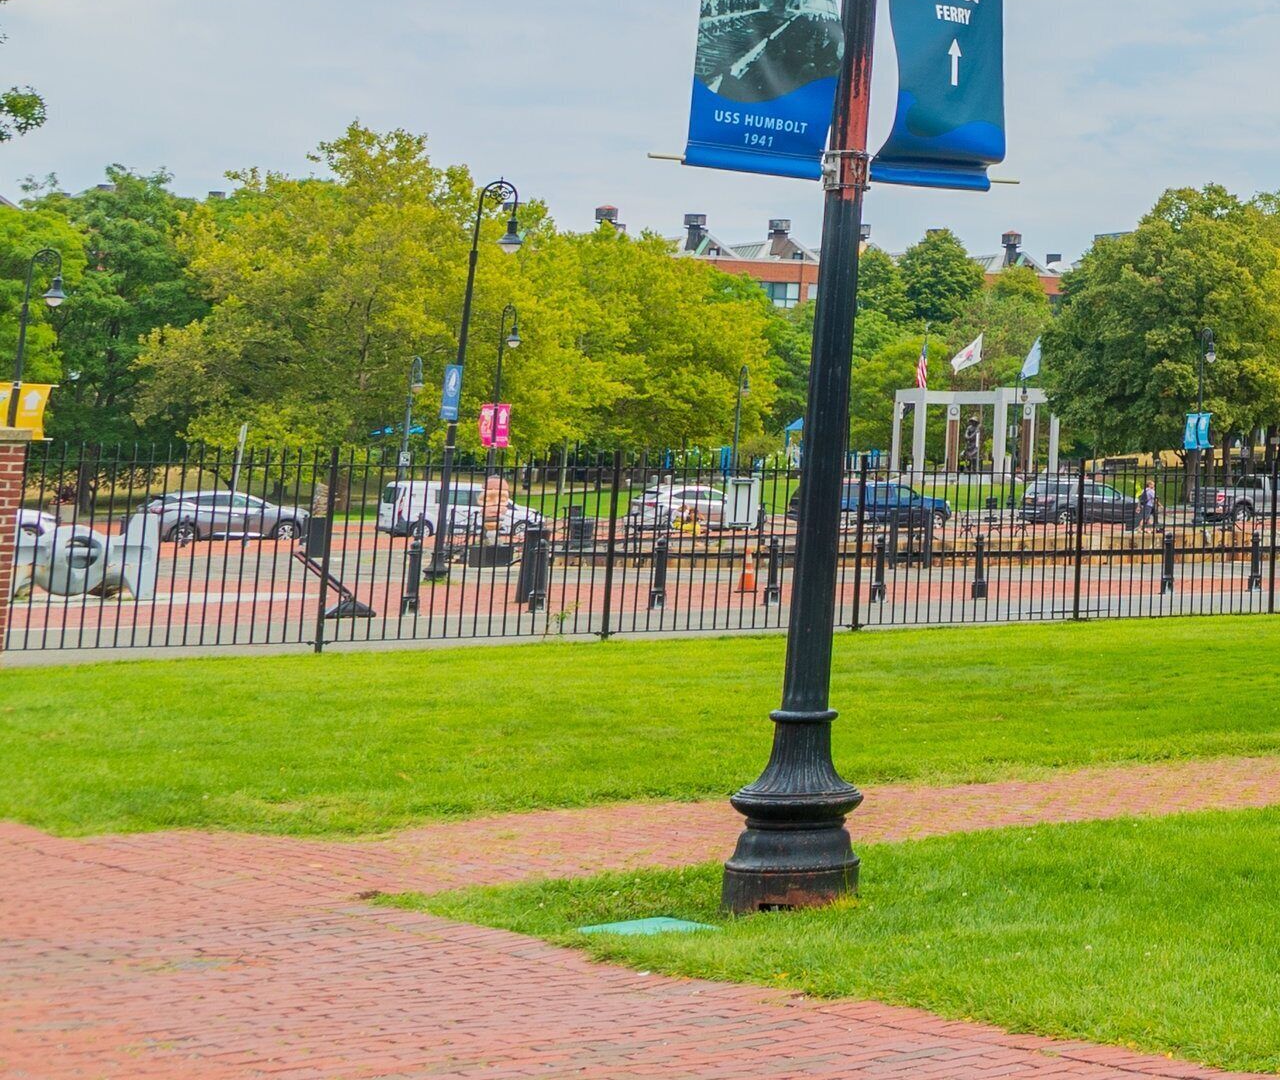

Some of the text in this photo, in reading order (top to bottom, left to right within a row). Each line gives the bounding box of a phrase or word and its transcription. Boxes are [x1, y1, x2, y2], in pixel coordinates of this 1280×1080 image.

[935, 4, 971, 25] FERRY
[714, 109, 808, 134] USS HUMBOLT
[743, 132, 774, 147] 1941
